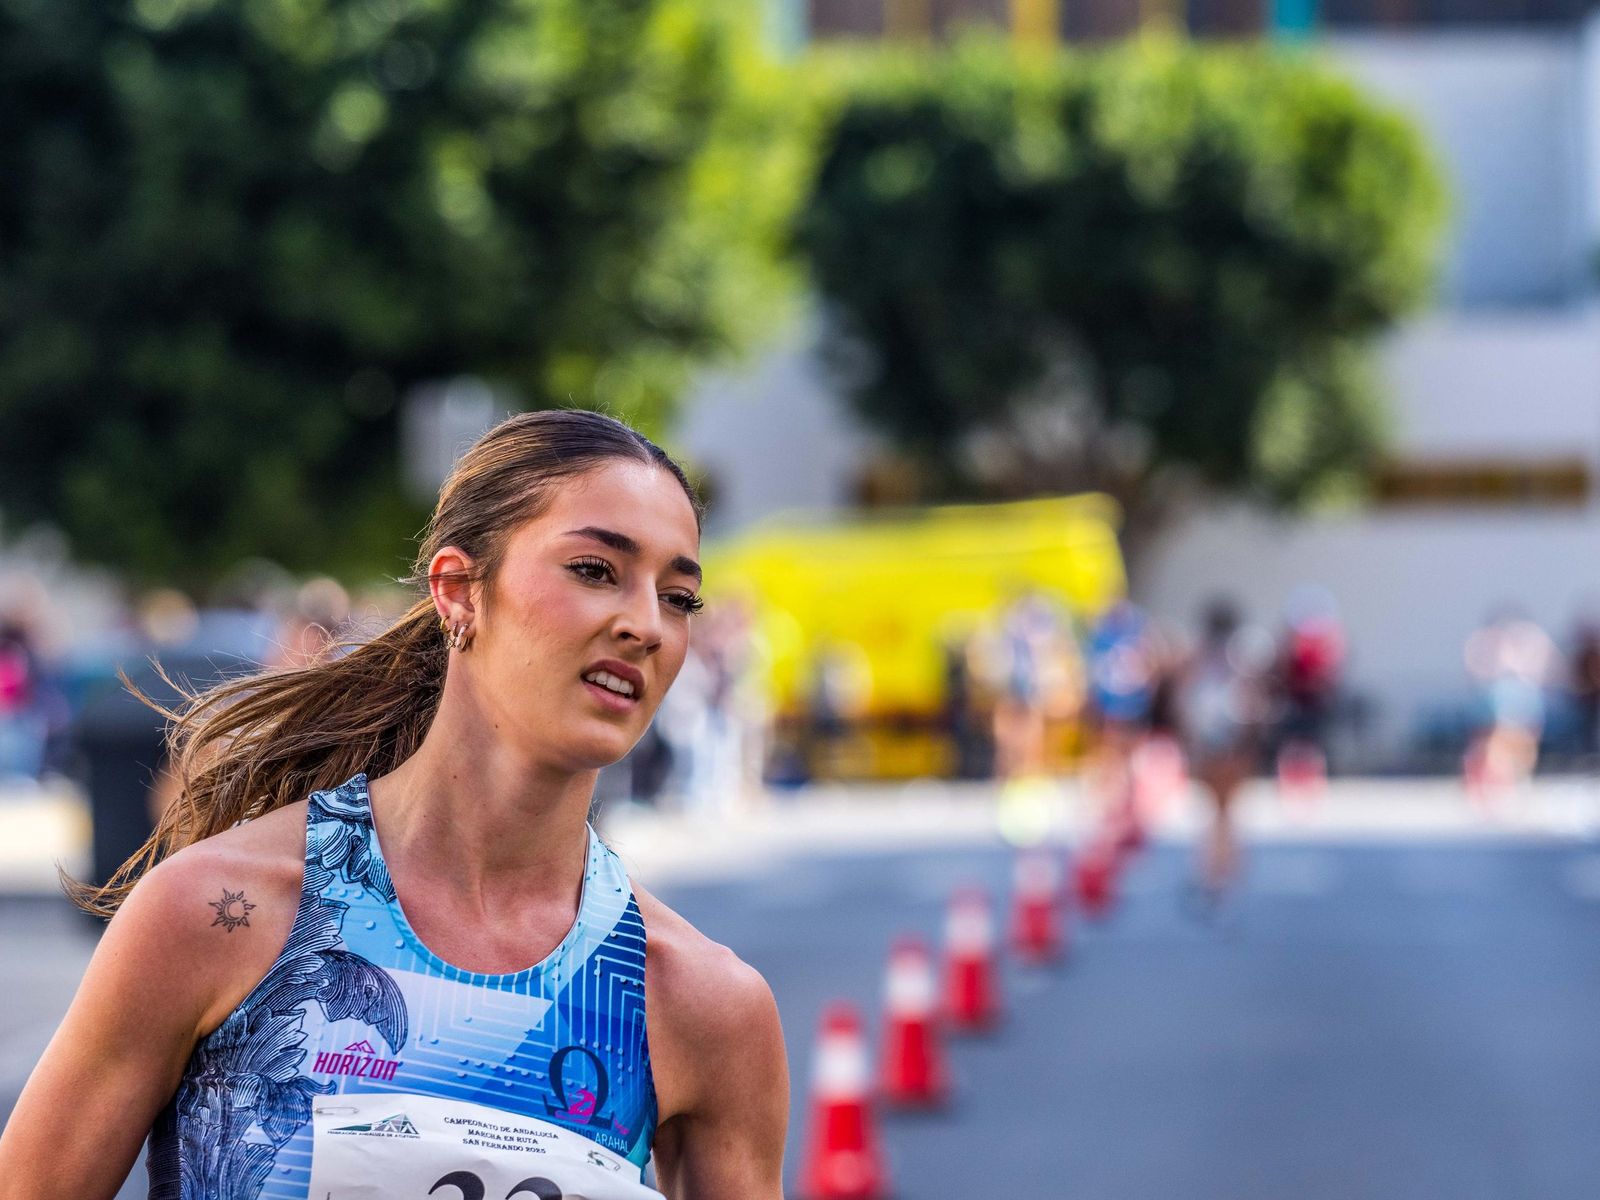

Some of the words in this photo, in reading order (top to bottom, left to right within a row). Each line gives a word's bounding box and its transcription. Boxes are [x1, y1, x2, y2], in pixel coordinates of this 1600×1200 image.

[313, 1052, 398, 1081] HORIZON
[444, 1117, 499, 1131] CAMPEONATO
[500, 1126, 511, 1134] DE
[468, 1129, 502, 1141] MARCHA
[517, 1136, 538, 1145] RUTA
[594, 1132, 629, 1153] ARAHAL
[463, 1138, 480, 1146] SAN
[482, 1140, 524, 1152] FERNANDO
[526, 1146, 547, 1154] 2025
